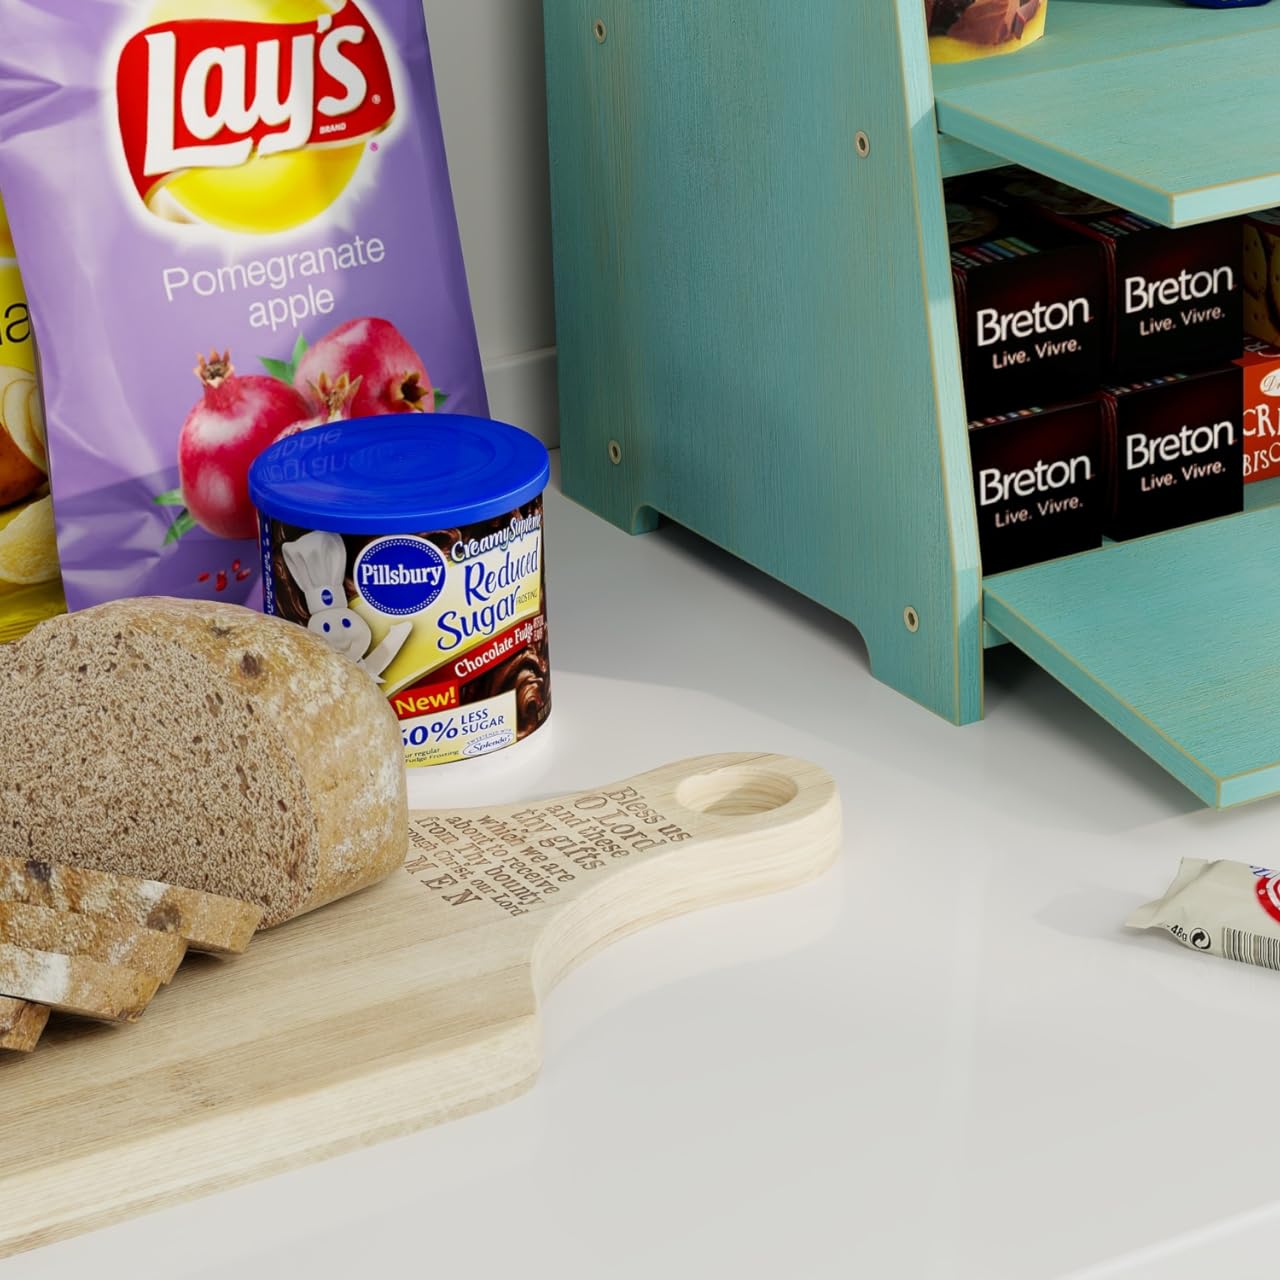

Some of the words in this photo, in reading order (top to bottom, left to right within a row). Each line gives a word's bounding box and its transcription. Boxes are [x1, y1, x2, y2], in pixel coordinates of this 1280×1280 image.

[142, 14, 368, 177] Lay's
[319, 121, 347, 135] BRAND
[162, 235, 386, 302] Pomegranate
[1124, 265, 1235, 315] Breton
[248, 285, 336, 332] apple
[976, 297, 1091, 348] Breton
[1140, 317, 1177, 337] Live.
[1181, 305, 1226, 327] Vivre.
[992, 350, 1031, 370] Live.
[1035, 337, 1082, 360] Vivre.
[1125, 420, 1235, 471] Breton
[978, 455, 1093, 507] Breton
[1141, 473, 1178, 492] Live.
[1181, 461, 1226, 482] Vivre.
[995, 508, 1033, 528] Live.
[1037, 496, 1084, 517] Vivre.
[450, 524, 512, 564] Creamy
[361, 563, 444, 588] Pillsbury
[464, 535, 539, 606] Reduced
[436, 585, 521, 651] Sugar
[454, 638, 515, 679] Chocolate
[395, 686, 457, 715] New!
[461, 707, 489, 726] LESS
[461, 715, 505, 736] SUGAR
[545, 804, 591, 829] and
[578, 824, 631, 859] these
[574, 795, 608, 810] O
[593, 808, 668, 852] Lord
[602, 786, 667, 825] Bless
[657, 822, 694, 843] us
[414, 816, 460, 846] from
[484, 864, 546, 906] bounty
[445, 816, 495, 846] about
[486, 843, 509, 858] to
[501, 856, 561, 895] receive
[477, 814, 529, 847] which
[519, 846, 550, 864] we
[540, 862, 577, 883] are
[538, 833, 607, 872] gifts
[470, 878, 497, 894] our
[490, 892, 530, 917] Lord
